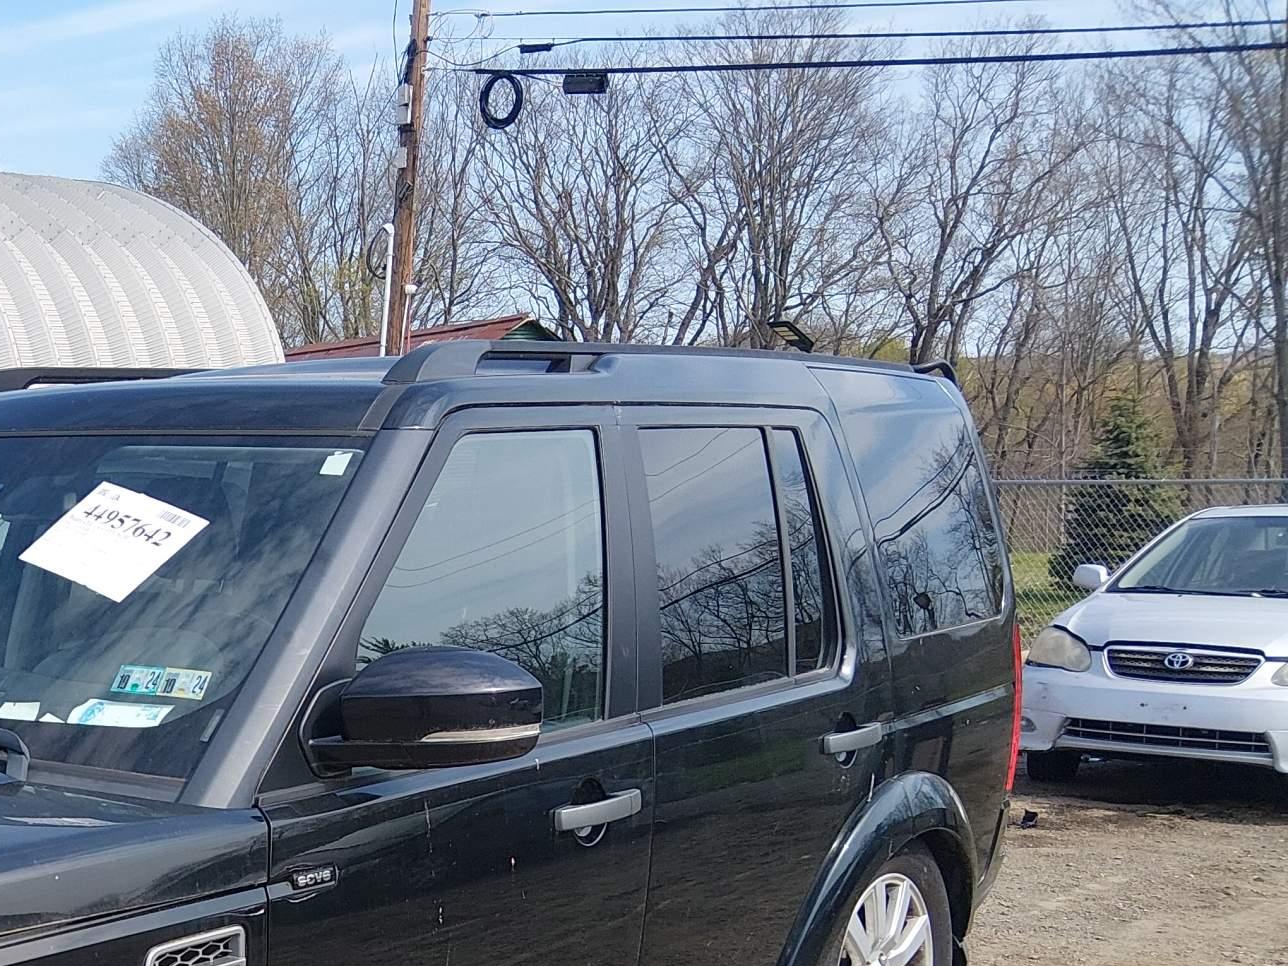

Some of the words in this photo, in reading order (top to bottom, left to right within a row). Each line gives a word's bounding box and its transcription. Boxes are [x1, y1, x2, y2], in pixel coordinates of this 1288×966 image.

[83, 504, 172, 547] 44957642
[145, 671, 162, 690] 24
[192, 675, 209, 694] 24
